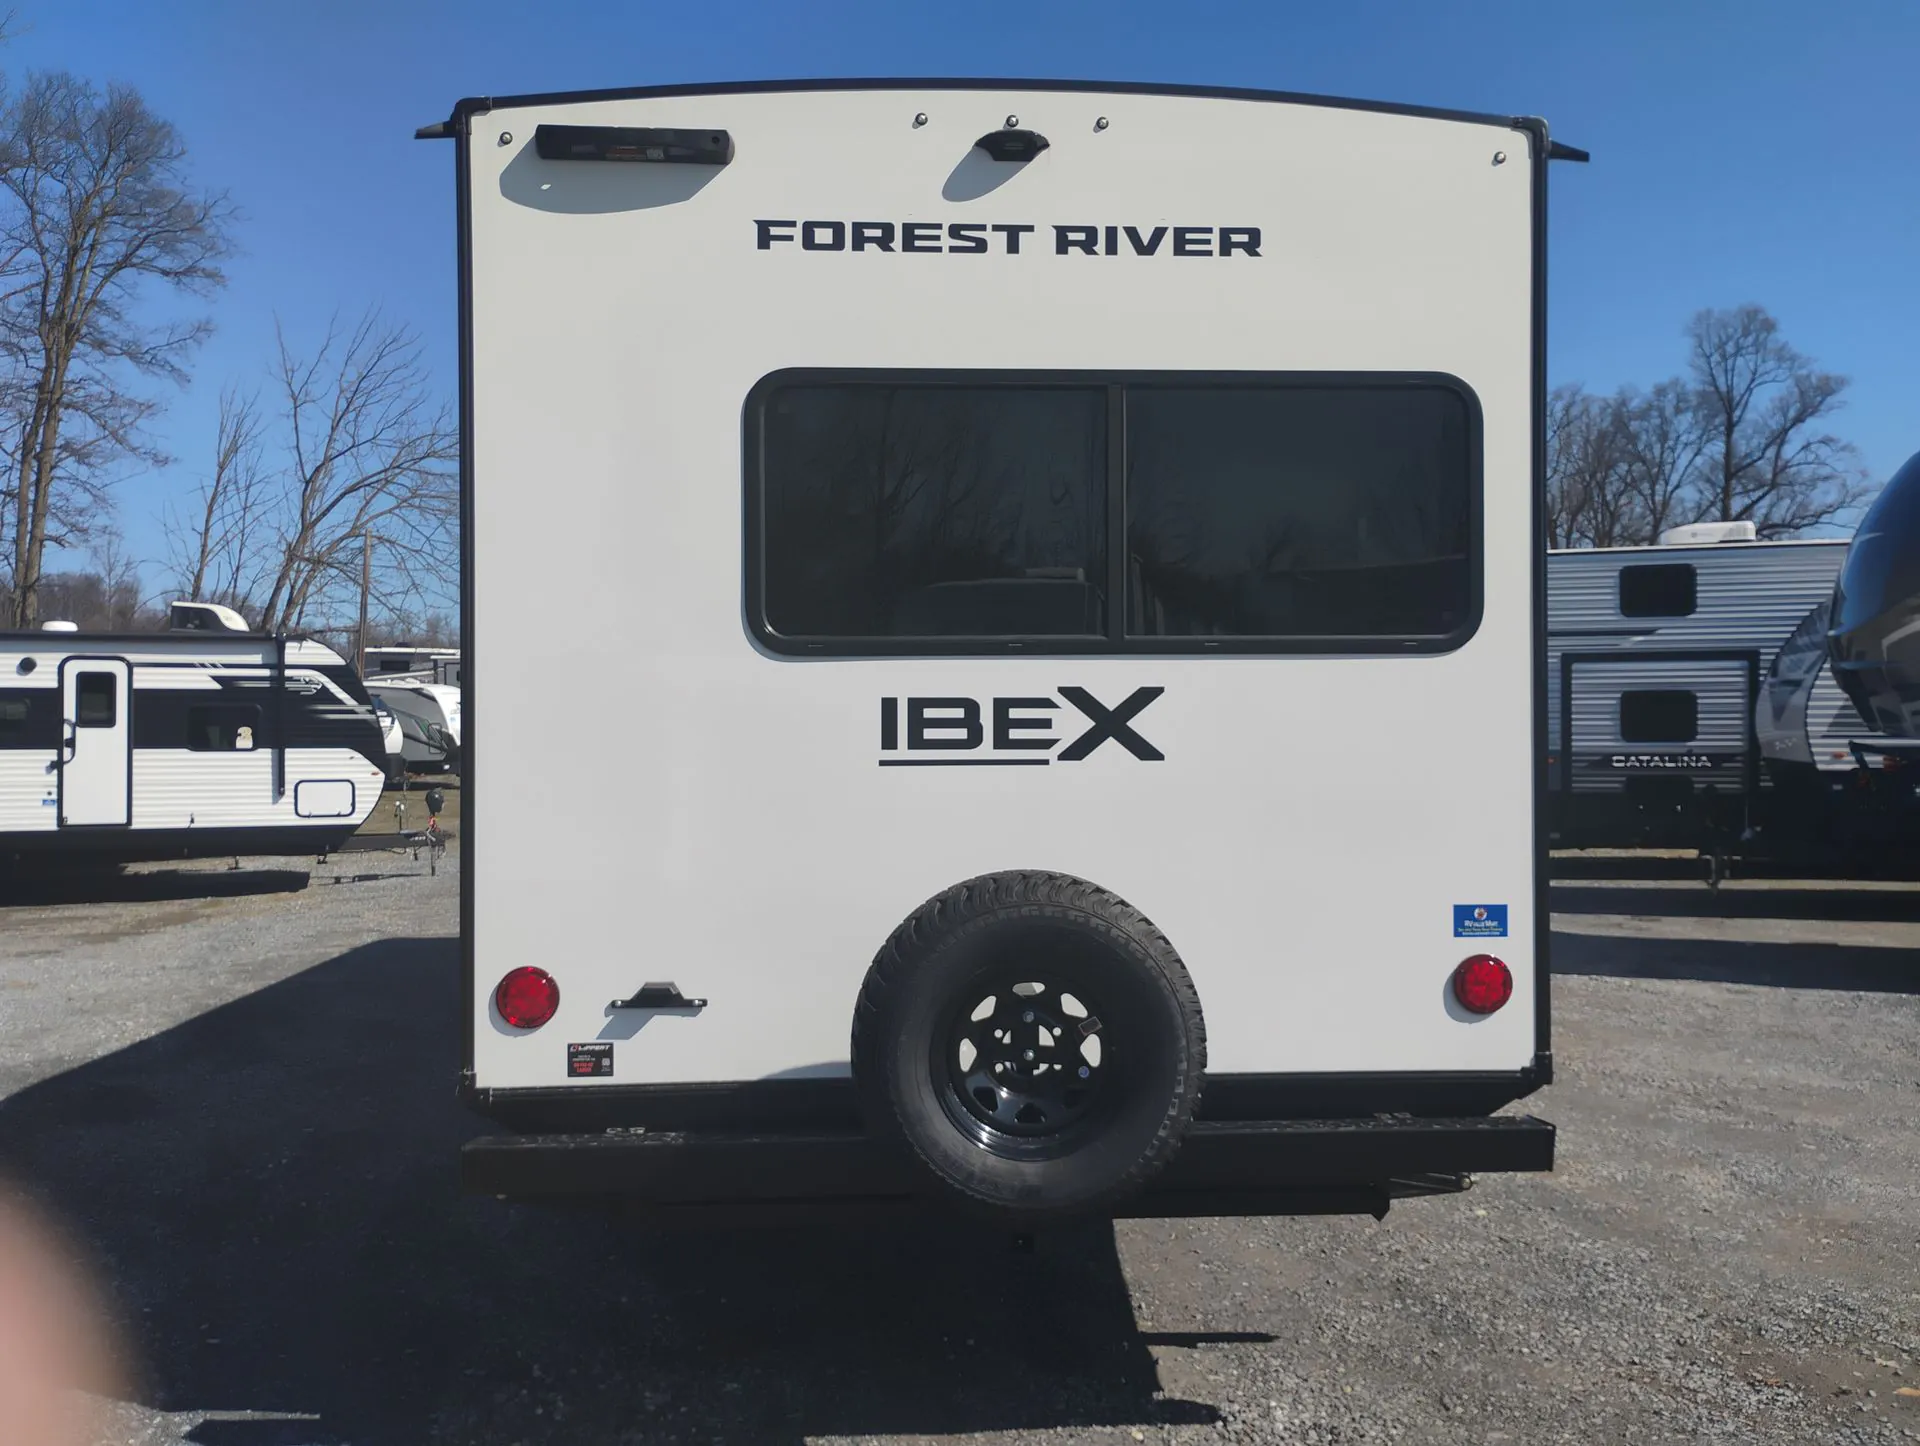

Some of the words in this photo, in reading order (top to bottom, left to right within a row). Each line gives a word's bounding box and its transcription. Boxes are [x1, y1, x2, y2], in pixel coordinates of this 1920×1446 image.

[753, 219, 1035, 254] FOREST
[1051, 225, 1263, 257] RIVER
[880, 686, 1165, 762] IBEX
[1611, 755, 1712, 768] CATALINA
